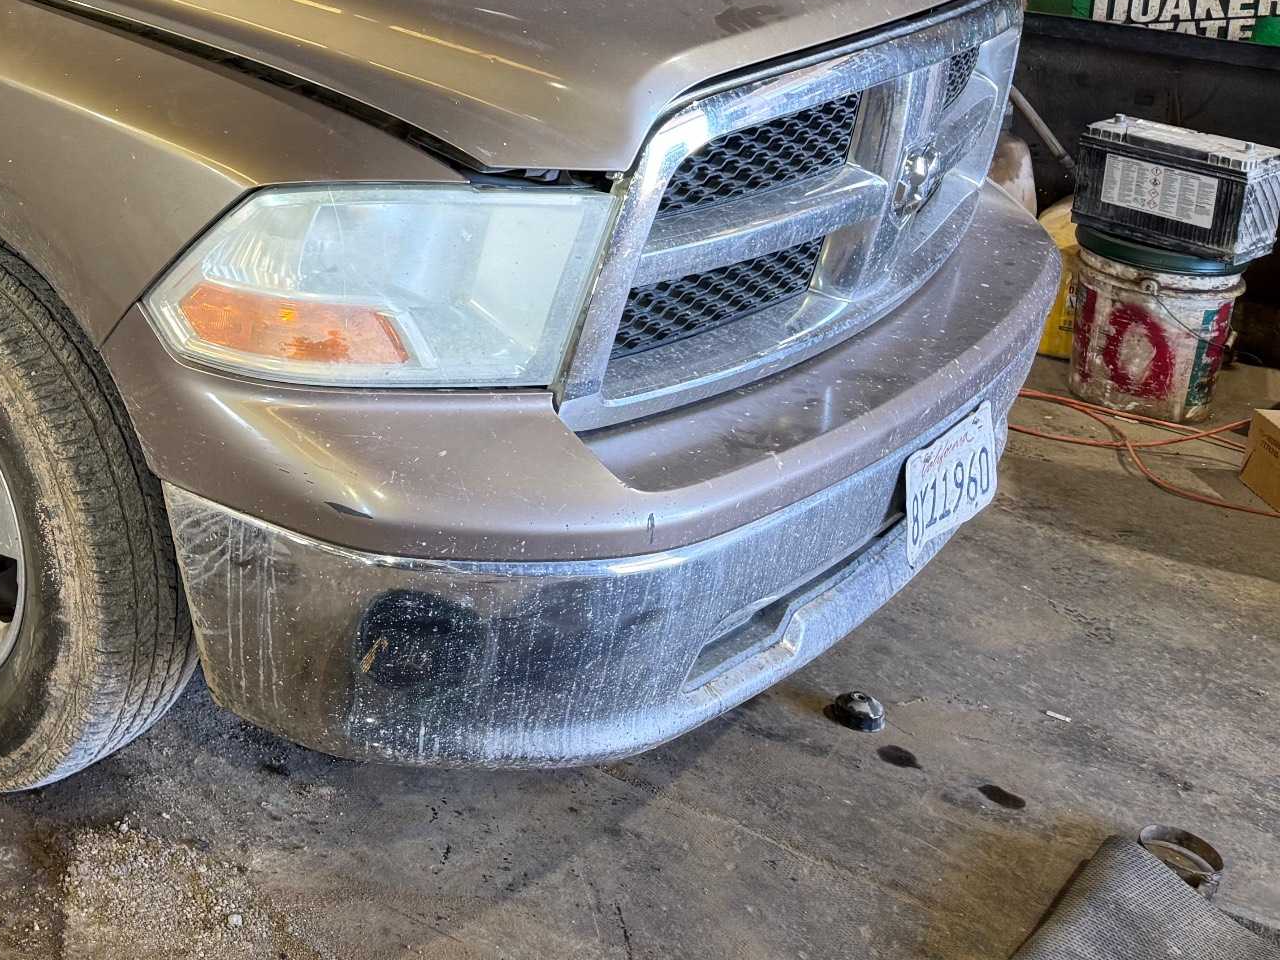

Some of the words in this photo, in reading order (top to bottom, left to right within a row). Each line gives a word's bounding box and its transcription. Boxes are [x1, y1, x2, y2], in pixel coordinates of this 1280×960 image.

[1122, 18, 1256, 41] ATE
[922, 431, 975, 478] California
[912, 446, 990, 546] 8Y11960
